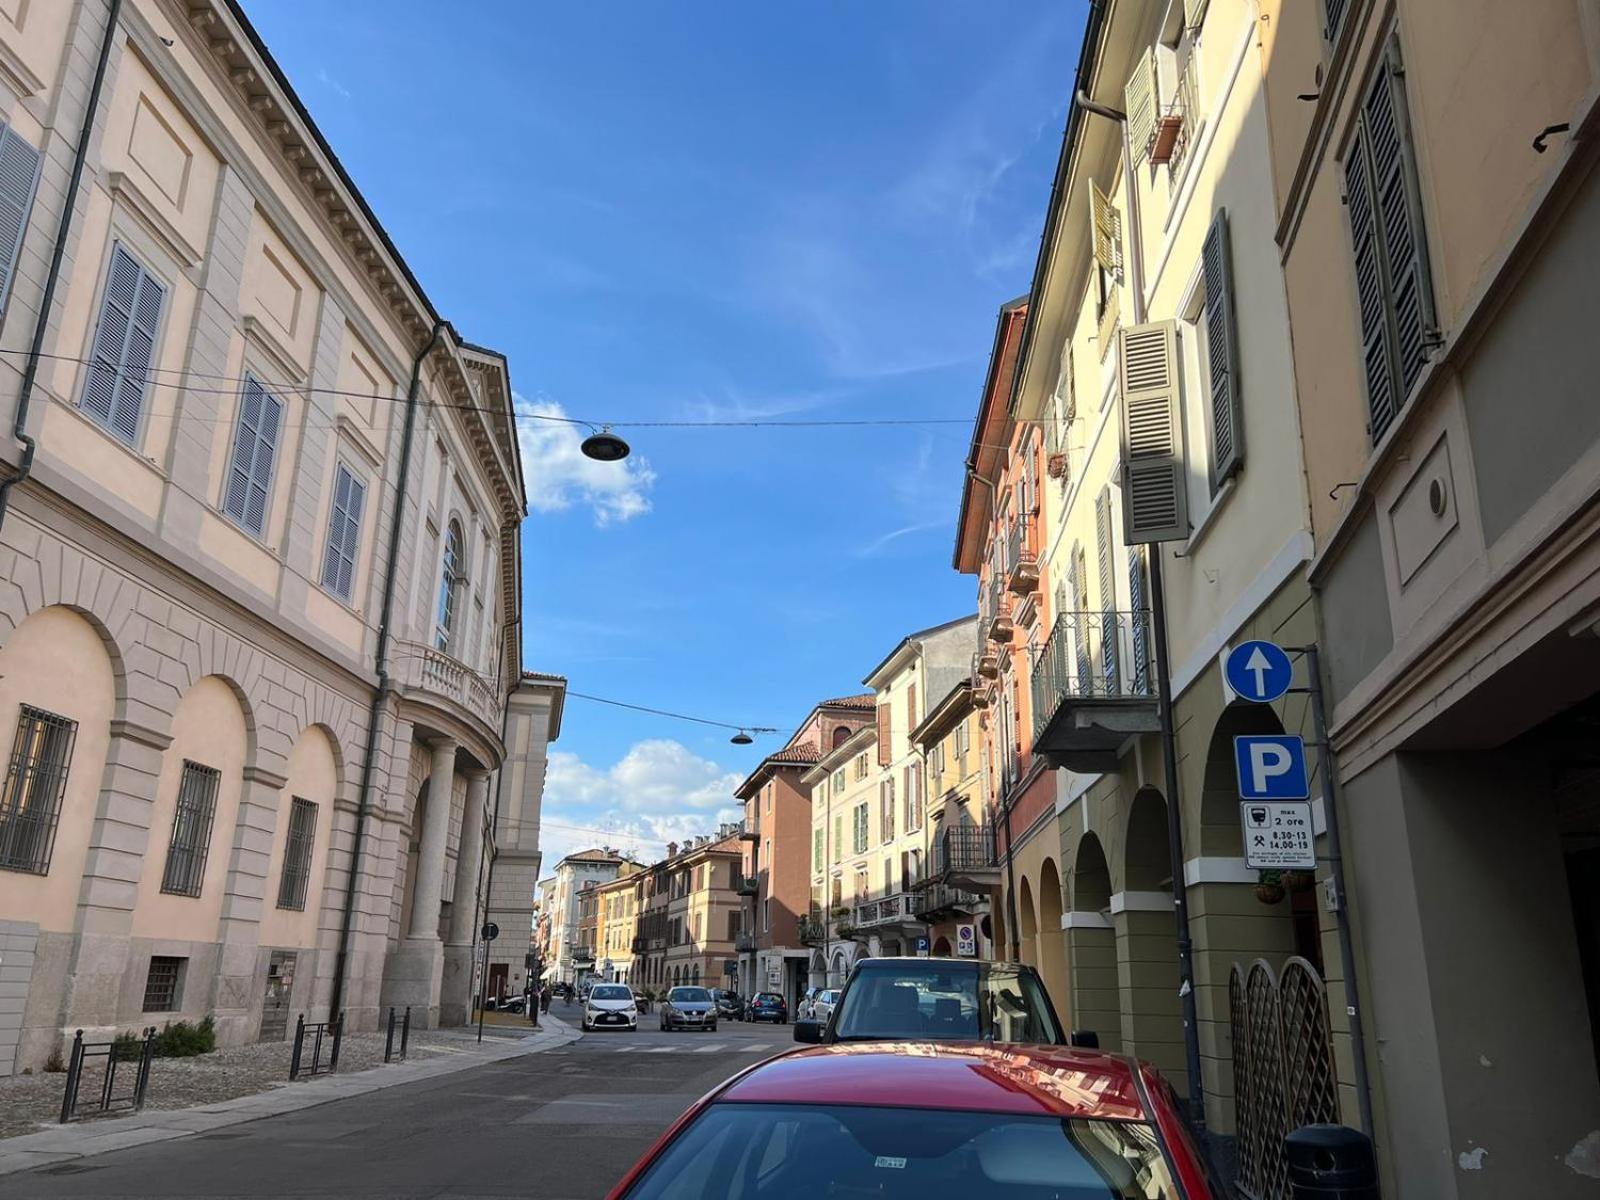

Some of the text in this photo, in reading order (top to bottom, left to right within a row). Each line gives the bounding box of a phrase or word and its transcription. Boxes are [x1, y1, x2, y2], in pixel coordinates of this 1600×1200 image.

[1250, 743, 1292, 792] P
[1275, 817, 1281, 826] 2
[1270, 841, 1308, 849] 14.00-19
[919, 939, 926, 949] P
